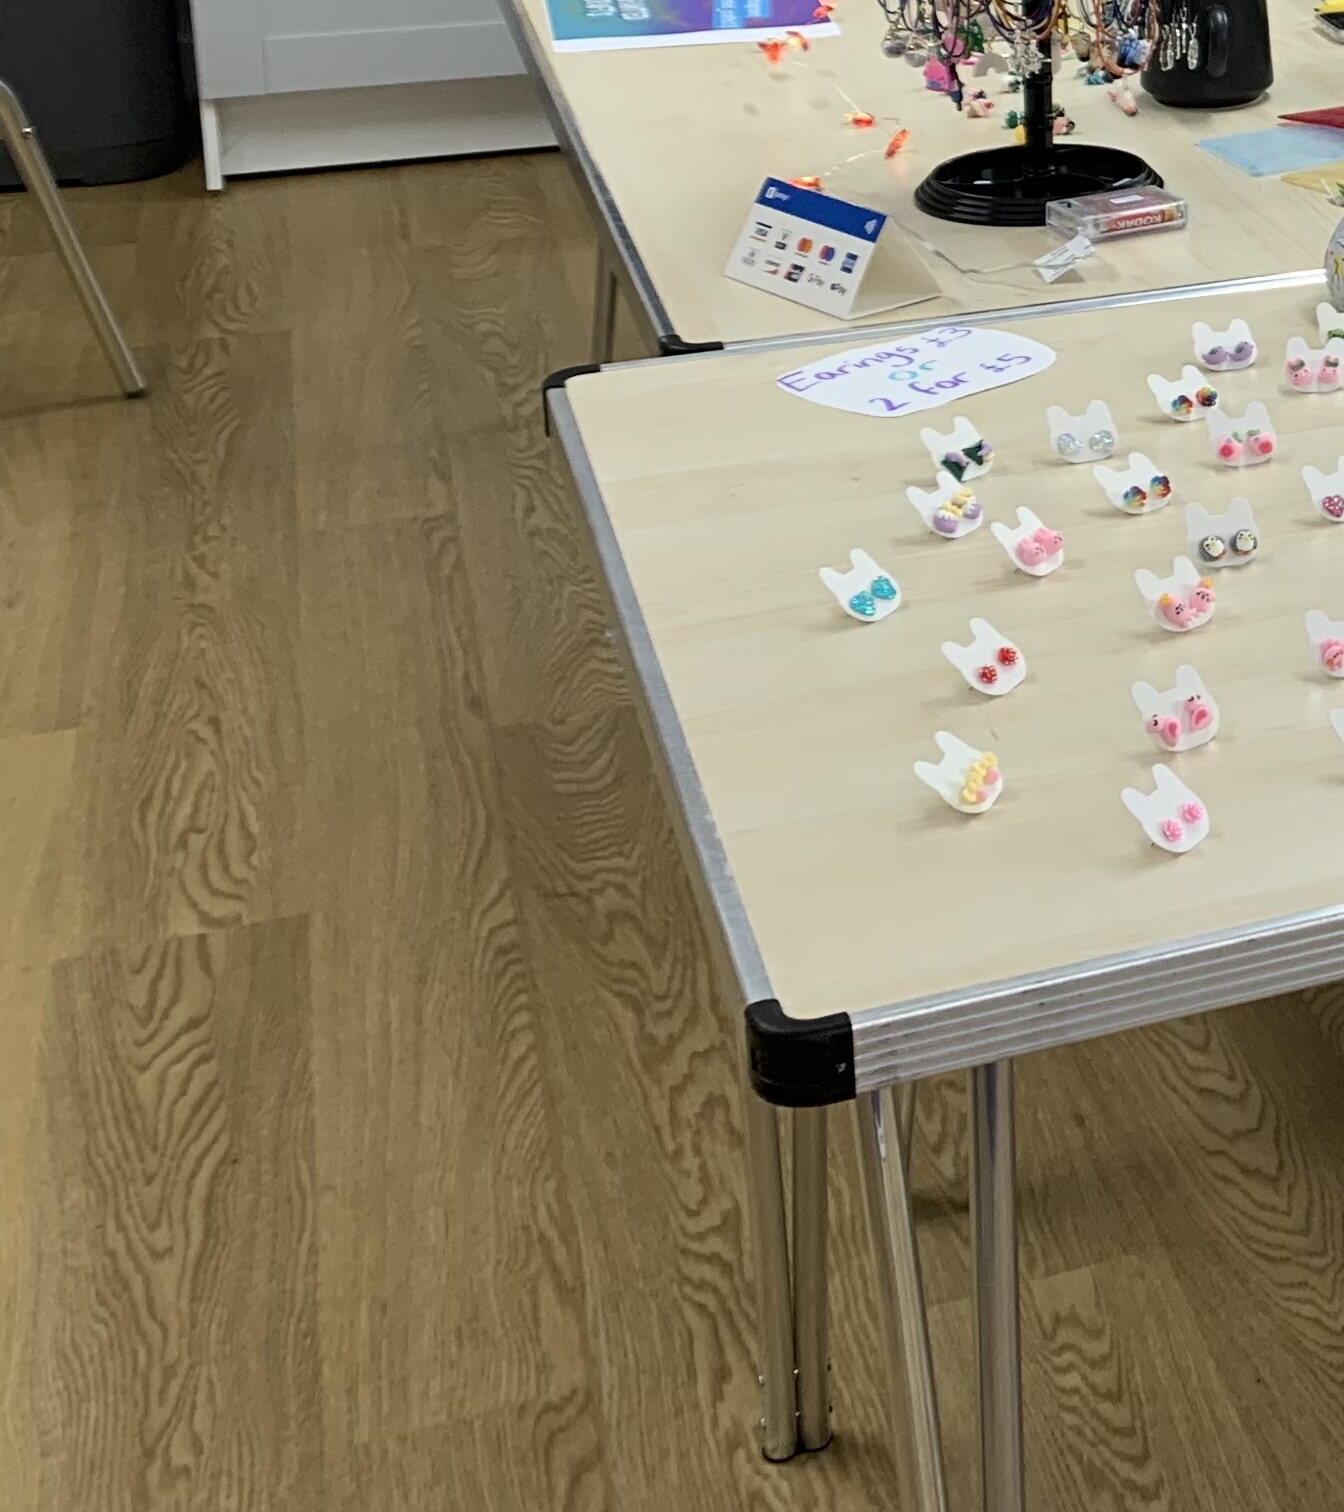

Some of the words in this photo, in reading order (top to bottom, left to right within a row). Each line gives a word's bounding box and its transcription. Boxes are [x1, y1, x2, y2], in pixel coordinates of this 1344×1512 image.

[1115, 214, 1163, 230] KODAK
[776, 345, 919, 392] Earings
[920, 327, 973, 348] £3
[868, 396, 911, 412] 2
[979, 352, 1033, 373] £5
